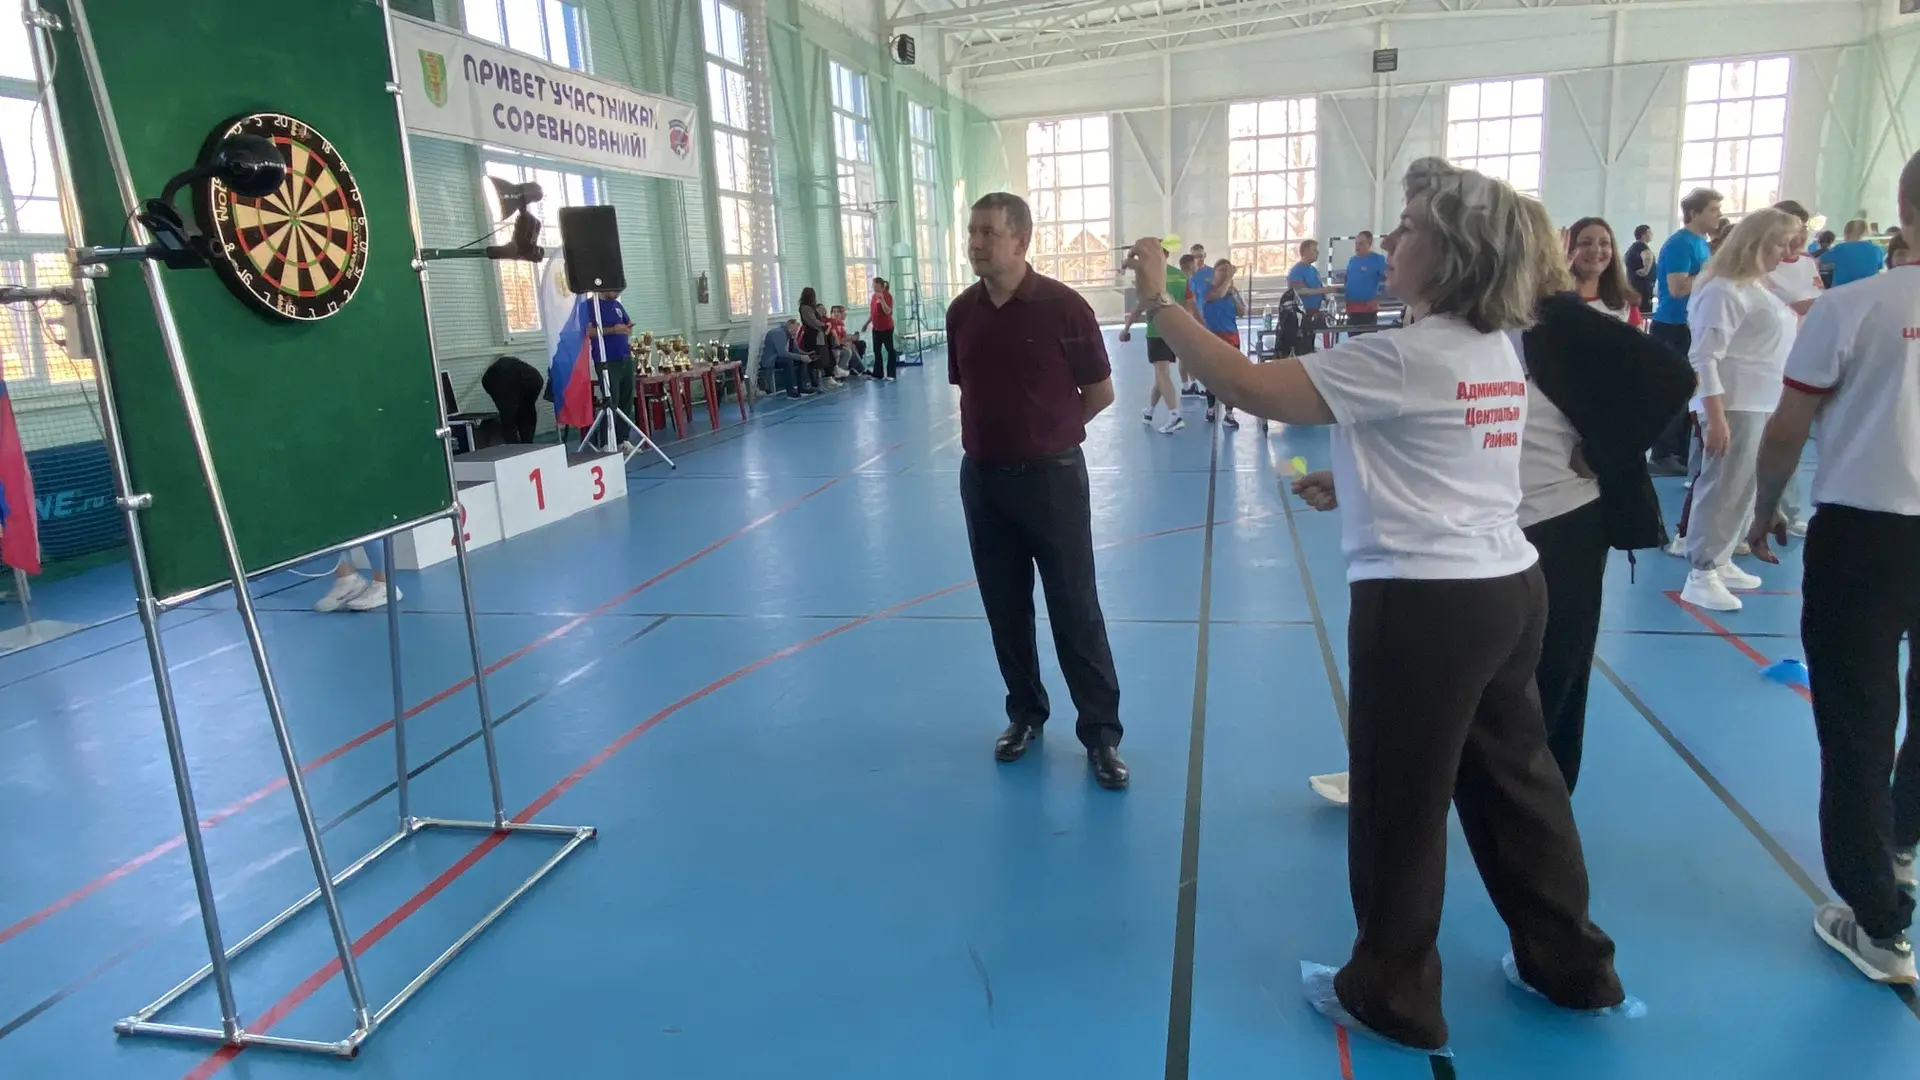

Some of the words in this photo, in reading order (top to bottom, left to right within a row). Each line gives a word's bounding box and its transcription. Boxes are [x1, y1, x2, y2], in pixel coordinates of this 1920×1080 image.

[463, 53, 546, 101] ПРИВЕТ
[274, 115, 288, 128] 20
[493, 102, 647, 159] СОРЕВНОВАНИЙ!
[321, 140, 331, 154] 18
[285, 304, 296, 318] 19
[327, 301, 338, 313] 17
[529, 468, 545, 511] 1
[590, 465, 606, 500] 3
